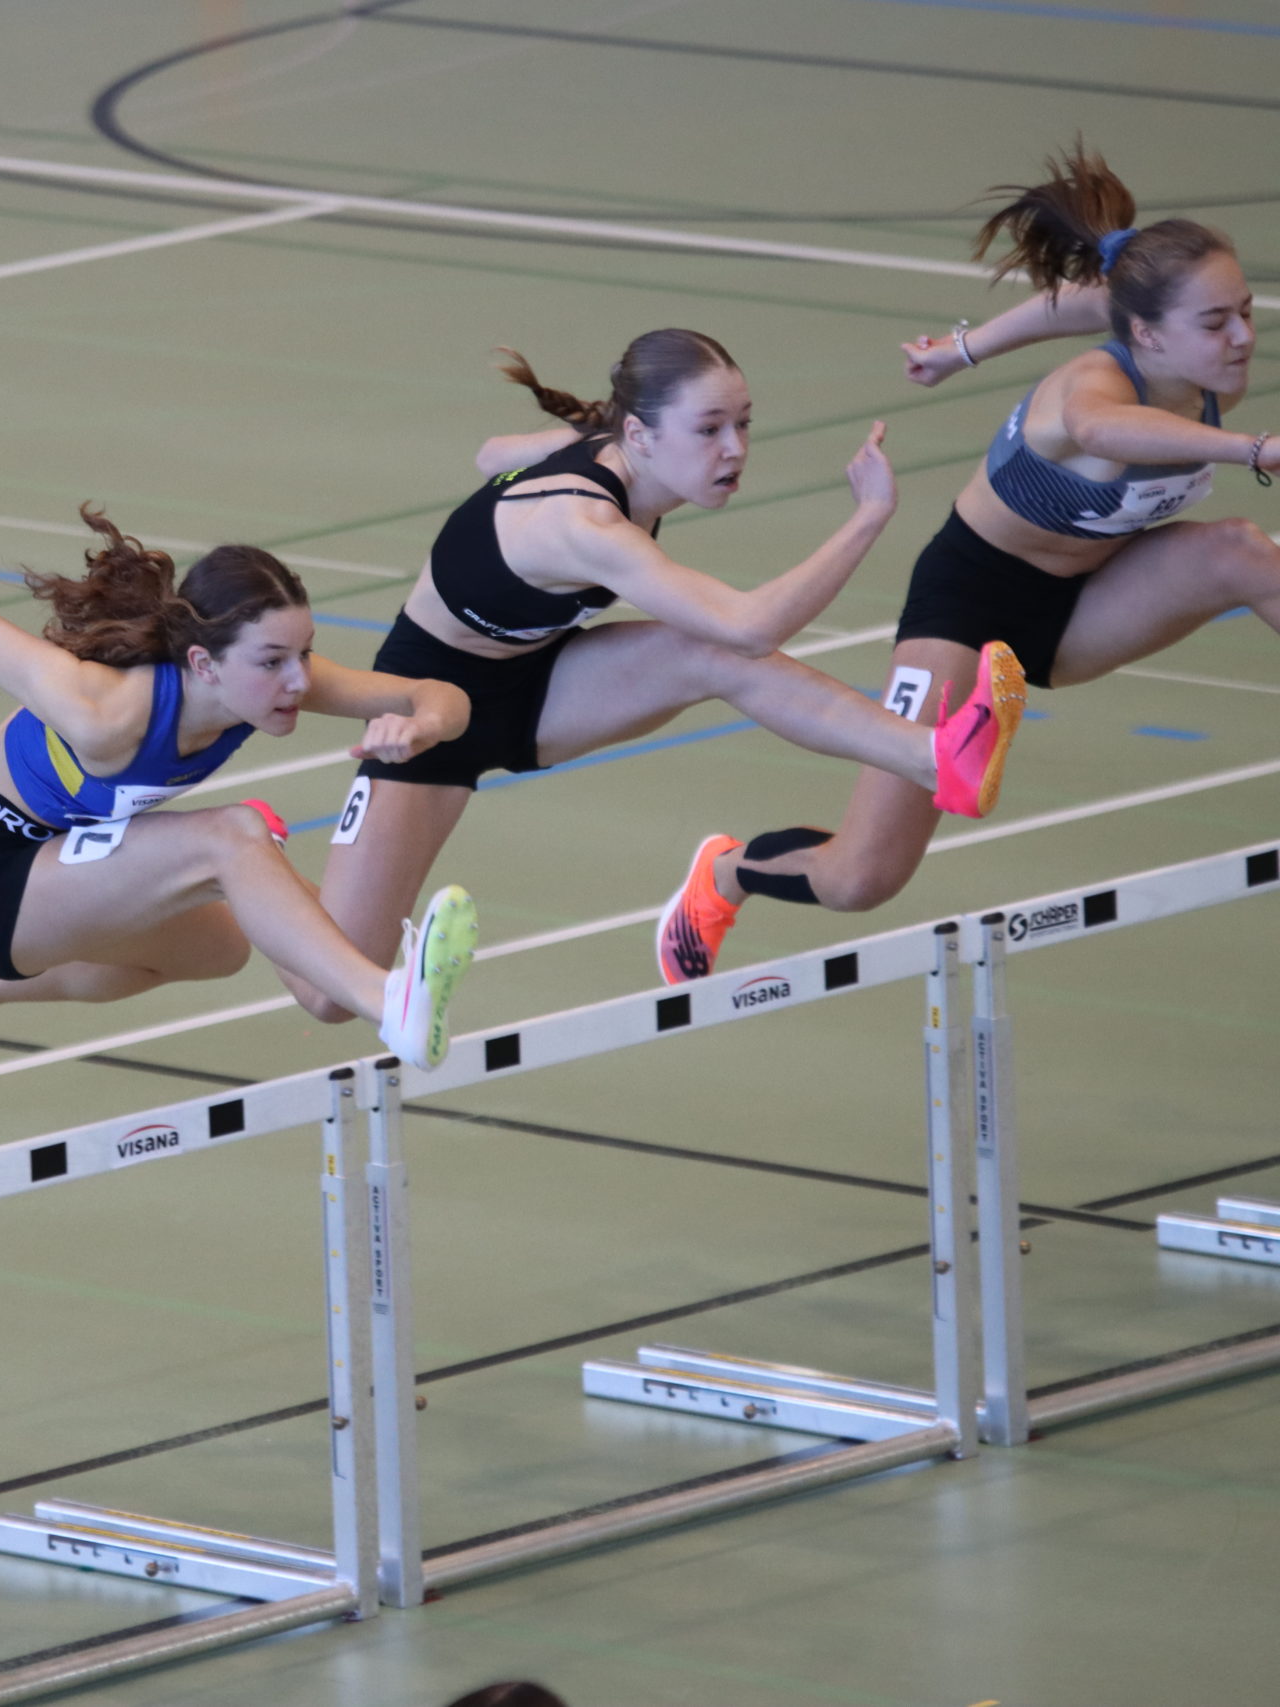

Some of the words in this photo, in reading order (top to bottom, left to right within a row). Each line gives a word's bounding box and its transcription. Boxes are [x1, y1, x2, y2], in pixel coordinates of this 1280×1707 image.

[892, 681, 919, 718] 5
[340, 790, 365, 833] 6
[73, 831, 113, 856] 7
[977, 1032, 987, 1089] ACTIVA
[979, 1095, 989, 1142] SPORT
[372, 1185, 382, 1243] ACTIVA
[375, 1249, 384, 1298] SPORT
